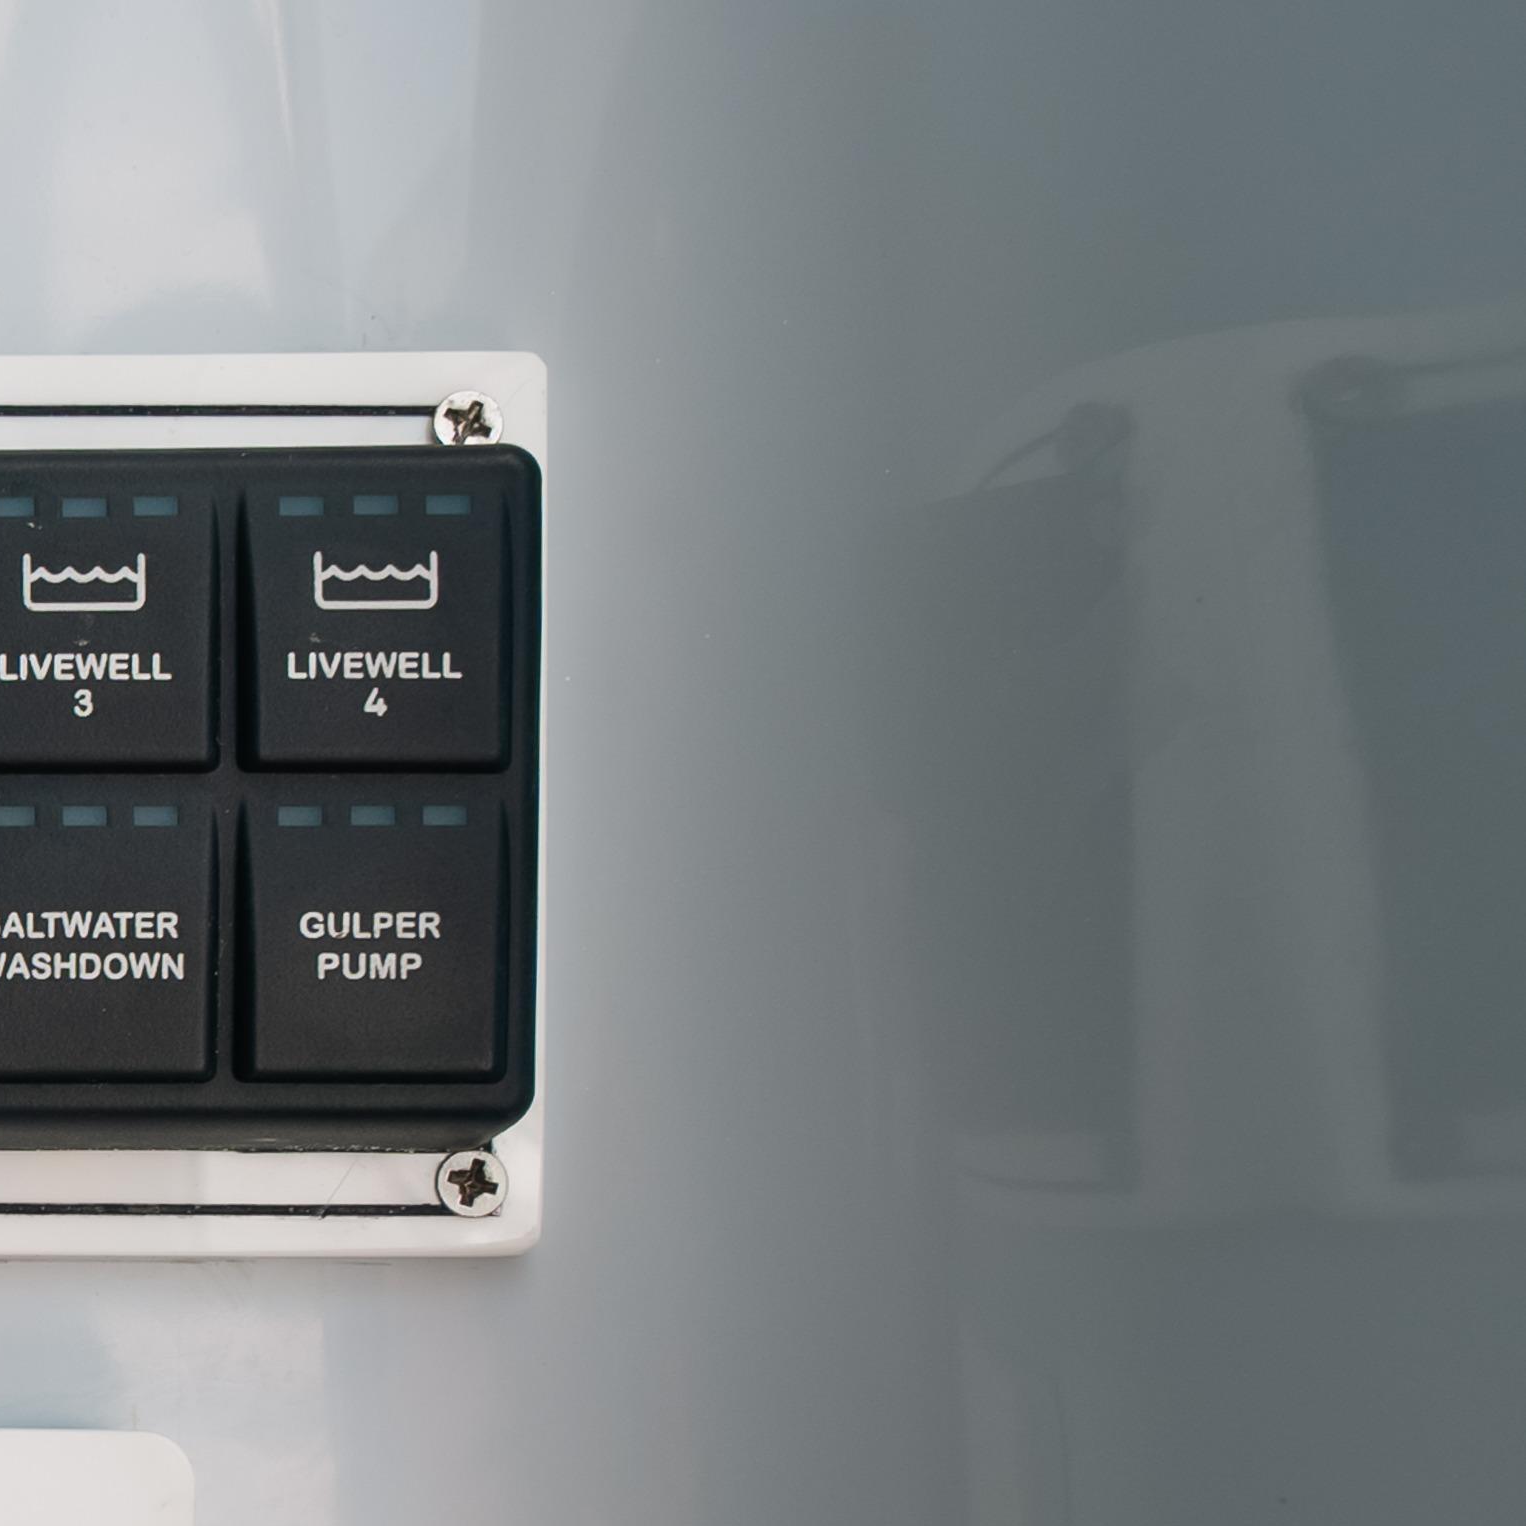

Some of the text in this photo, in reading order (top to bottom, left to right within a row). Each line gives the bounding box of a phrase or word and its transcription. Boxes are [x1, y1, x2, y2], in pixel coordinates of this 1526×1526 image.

[287, 651, 463, 680] LIVEWELL
[73, 688, 94, 718] 3
[363, 687, 388, 717] 4
[299, 911, 441, 939] GULPER
[317, 952, 423, 980] PUMP
